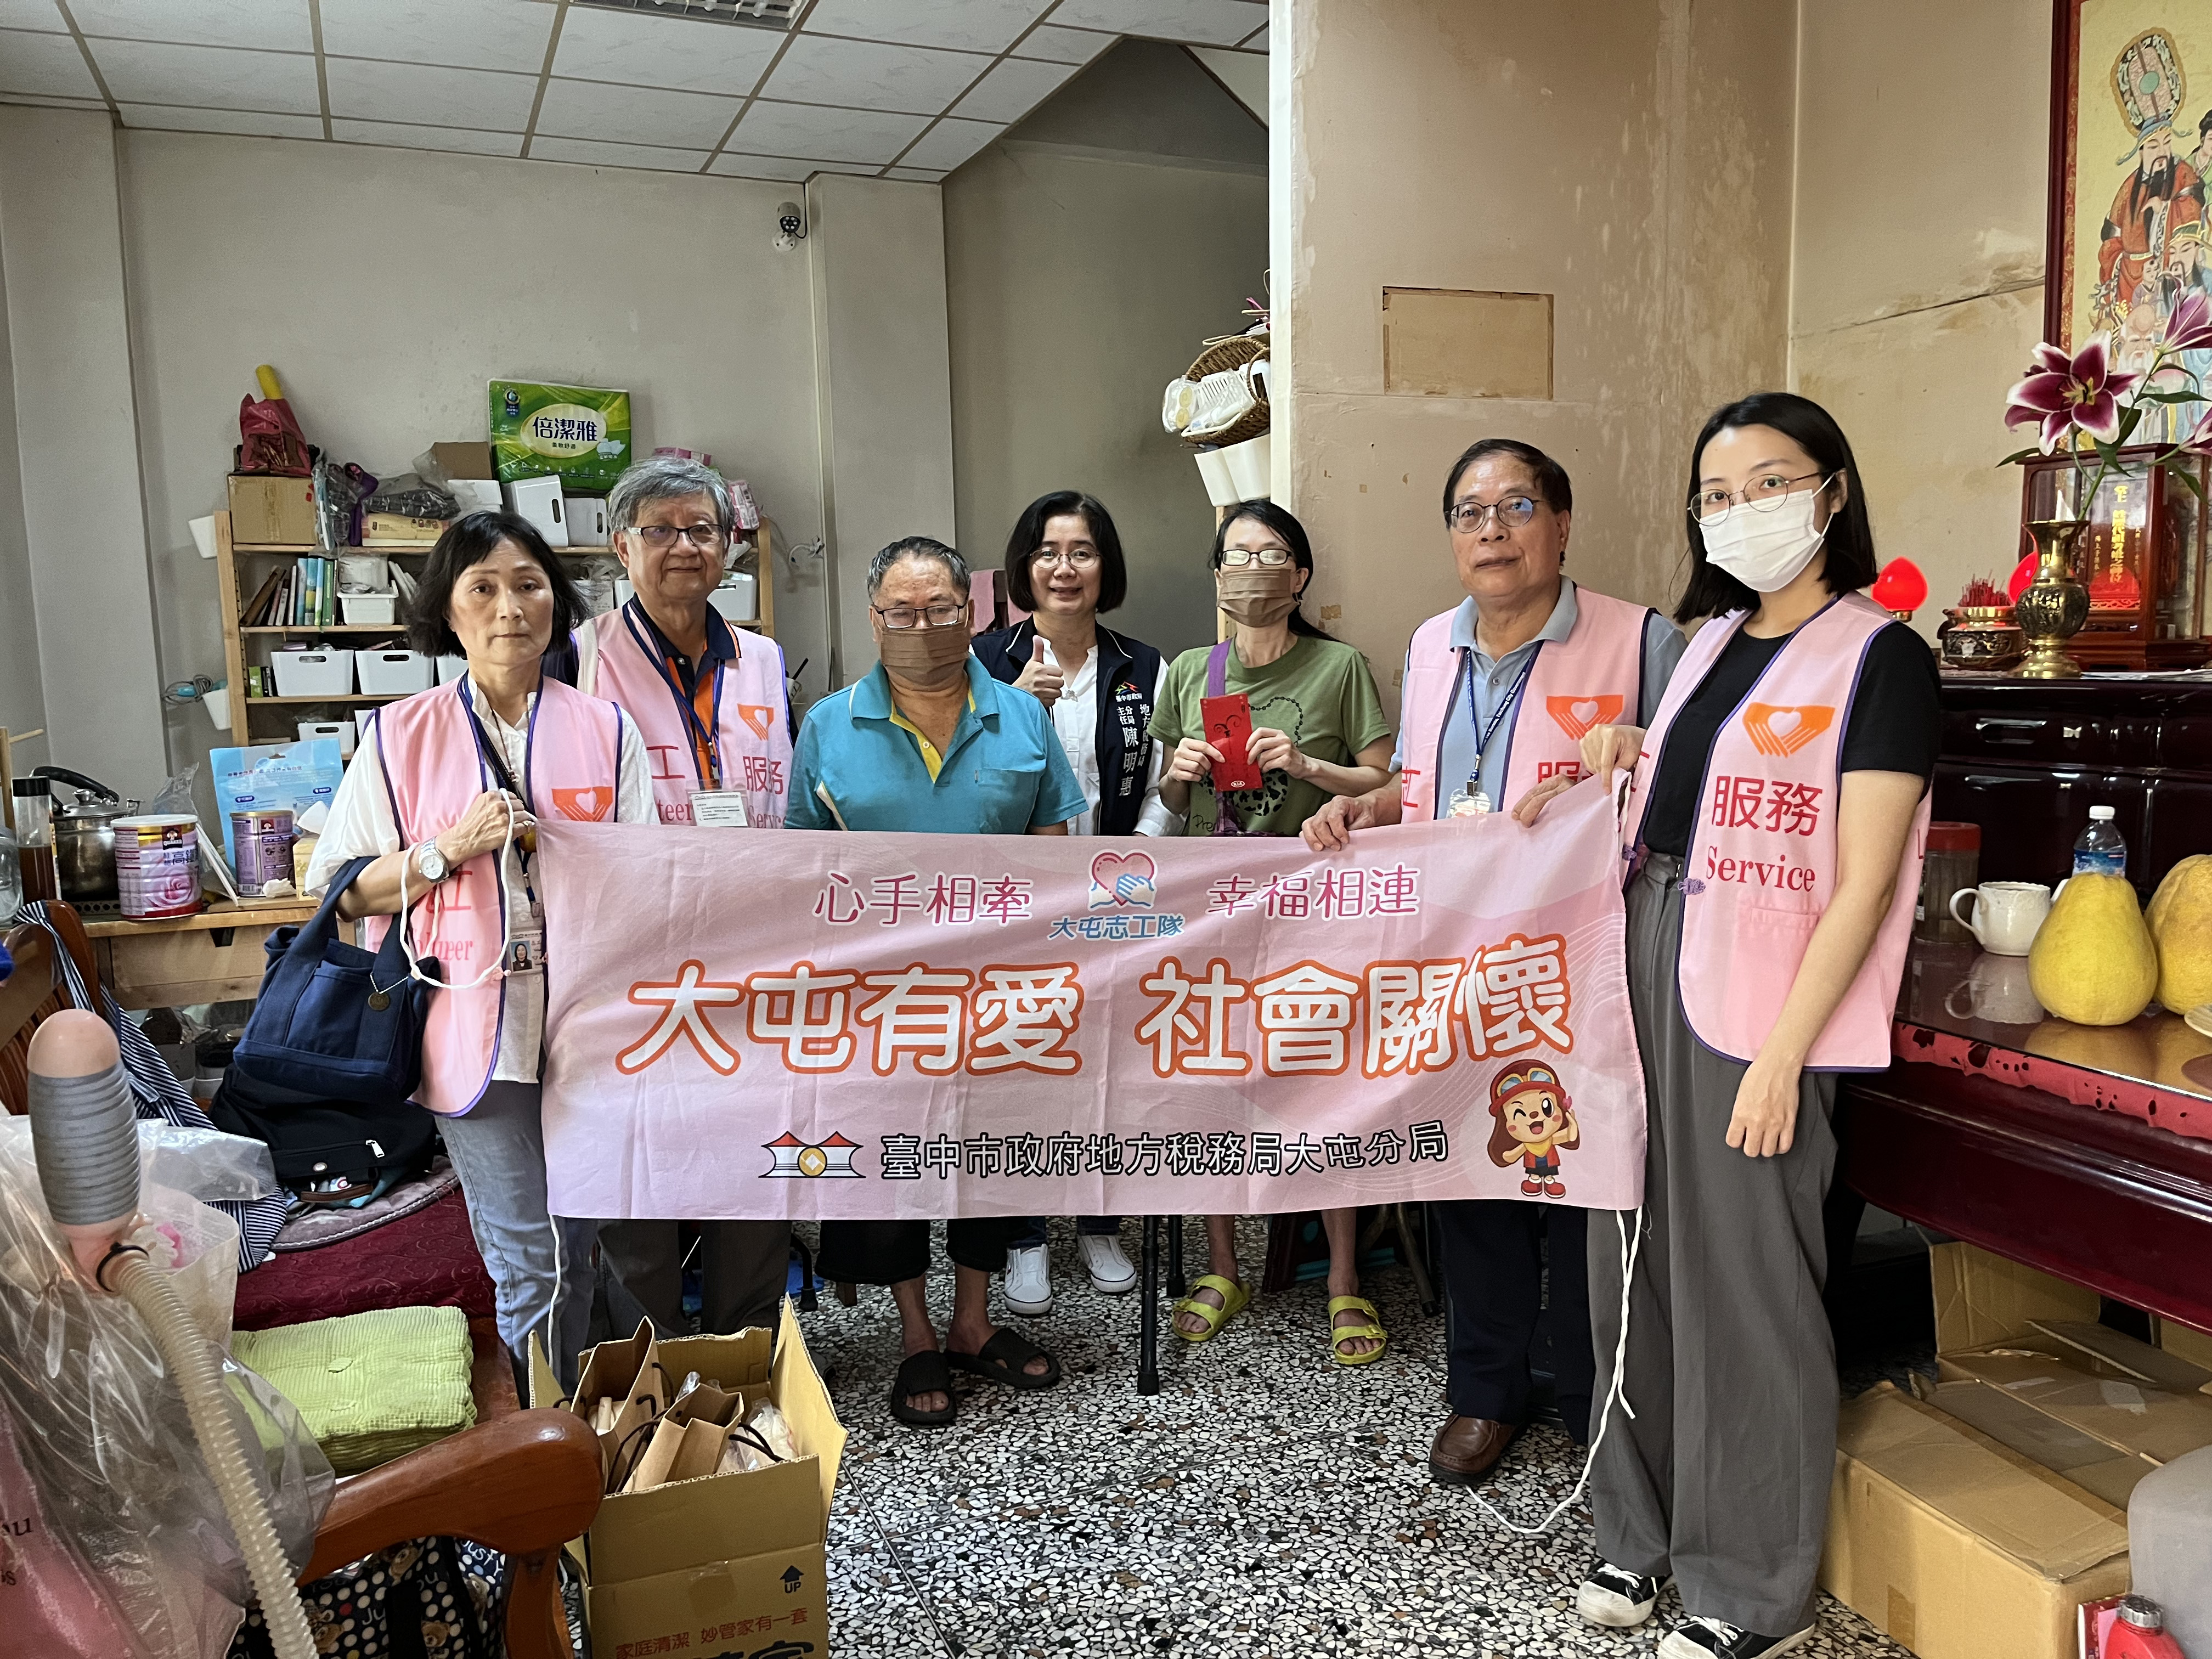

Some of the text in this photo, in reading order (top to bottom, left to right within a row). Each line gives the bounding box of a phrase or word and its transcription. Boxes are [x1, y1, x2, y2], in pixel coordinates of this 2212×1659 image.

[532, 416, 597, 441] 倍潔雅
[1119, 726, 1139, 796] 陳明惠
[1711, 775, 1823, 837] 服務
[1209, 864, 1420, 919] 幸福相連
[1706, 845, 1815, 892] Service
[815, 872, 1032, 926] 心手相牽
[1048, 915, 1184, 940] 大屯志工隊
[615, 933, 1573, 1080] 大屯有愛 社會關懷
[880, 1119, 1449, 1180] 臺中市政府地方稅務局大屯分局
[785, 1582, 802, 1594] UP
[616, 1632, 691, 1659] 家庭清潔
[701, 1607, 809, 1644] 妙管家有一套
